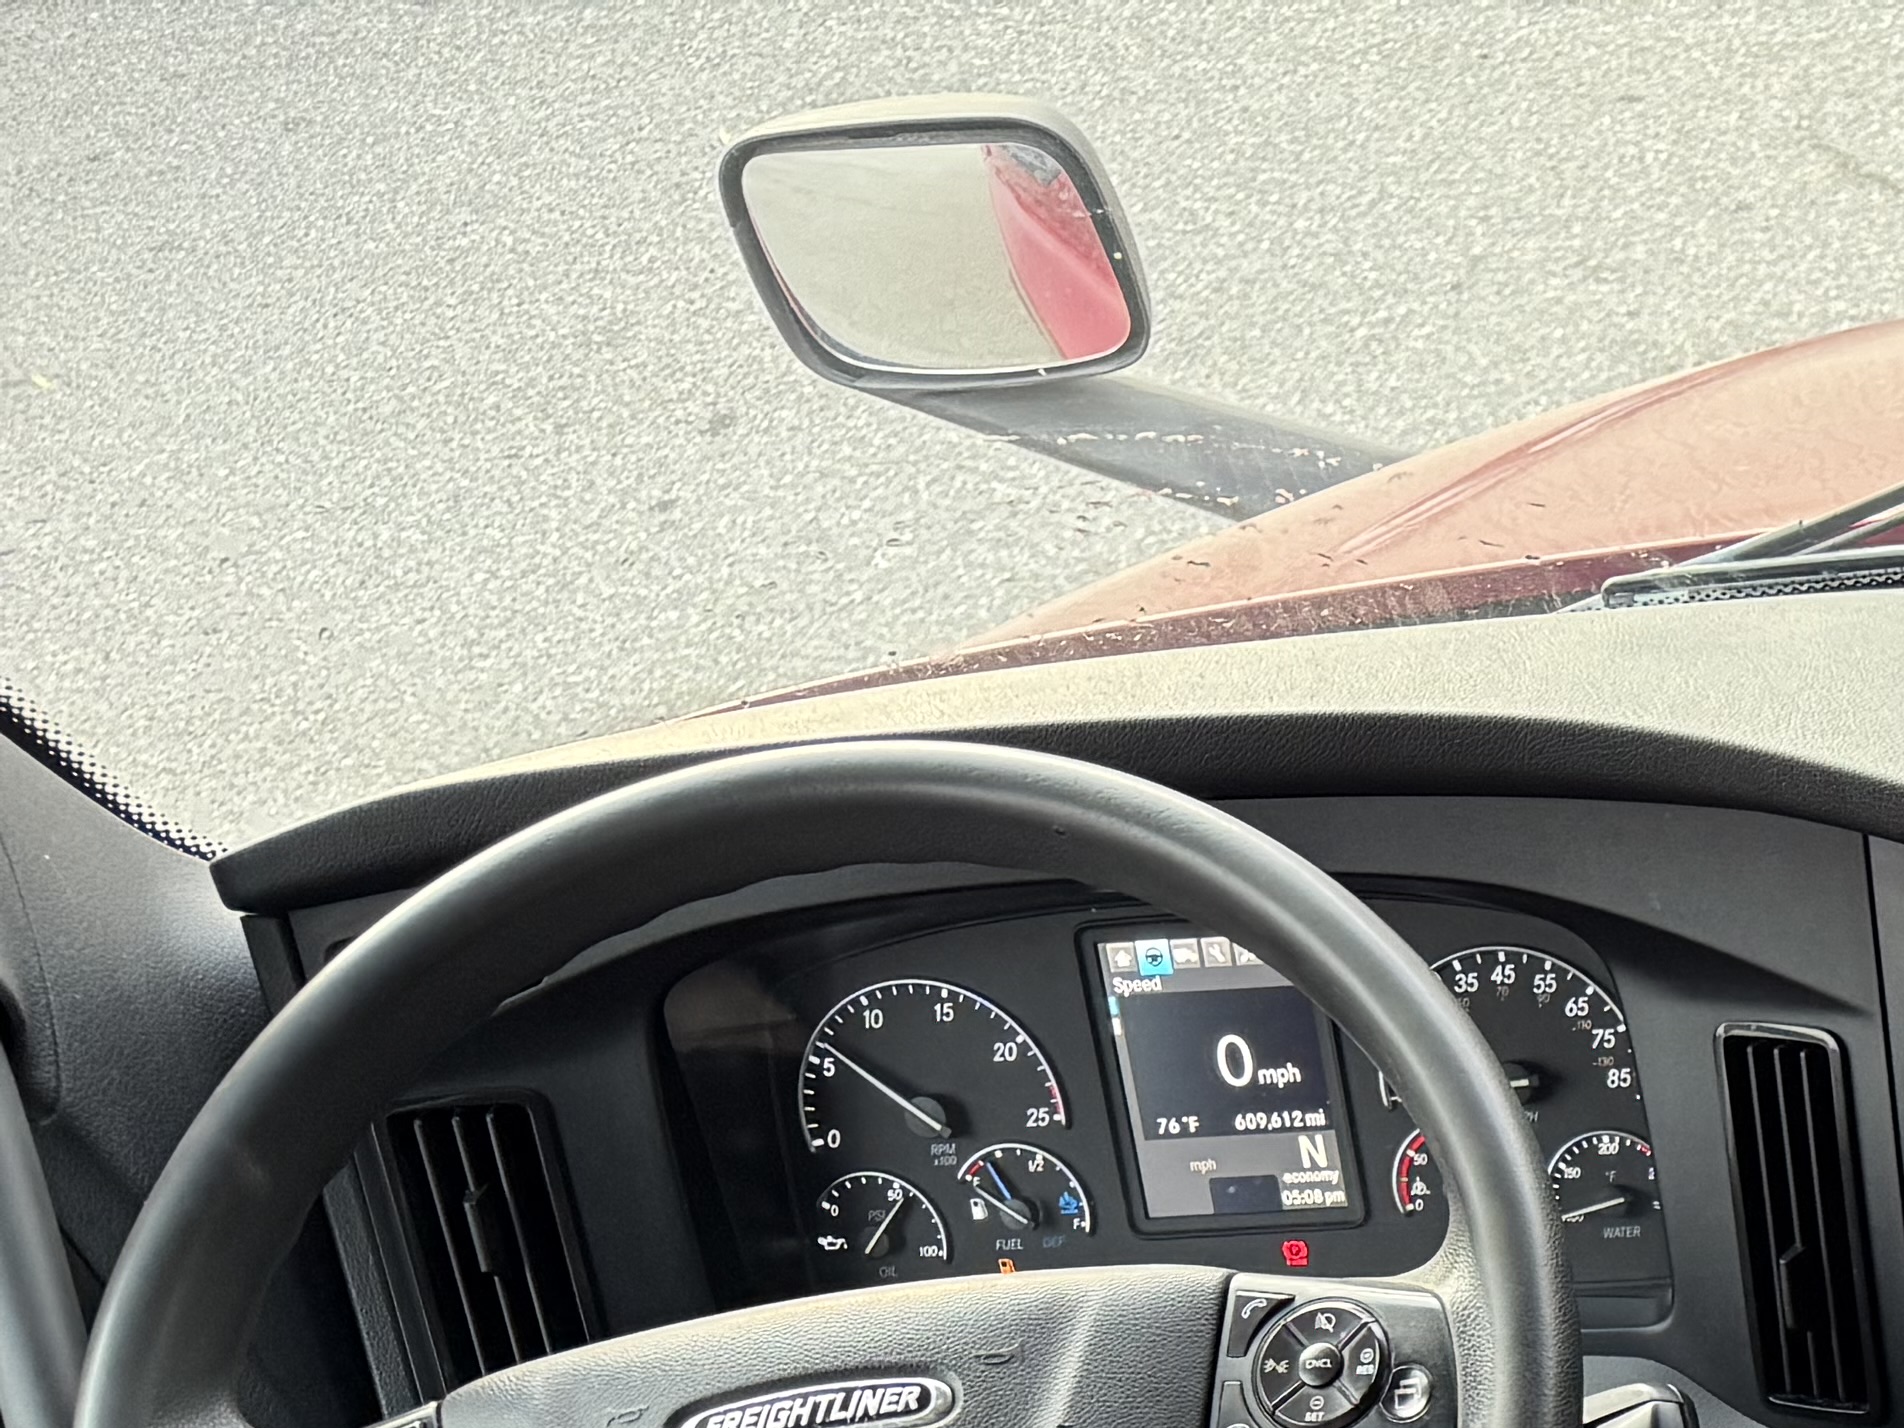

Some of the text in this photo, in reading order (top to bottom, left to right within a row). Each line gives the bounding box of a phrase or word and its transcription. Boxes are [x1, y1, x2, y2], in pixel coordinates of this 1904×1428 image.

[1454, 973, 1478, 993] 35
[1491, 965, 1515, 984] 45
[1533, 974, 1557, 994] 55
[1112, 976, 1162, 997] Speed
[934, 1003, 954, 1022] 15
[1565, 997, 1589, 1017] 65
[863, 1009, 883, 1029] 10
[1591, 1029, 1616, 1049] 75
[993, 1042, 1017, 1061] 20
[1217, 1034, 1302, 1088] 0 mph
[823, 1058, 835, 1077] 5
[1606, 1069, 1631, 1088] 85
[1026, 1108, 1049, 1127] 25
[827, 1129, 841, 1148] 0
[1298, 1134, 1328, 1168] N
[1599, 1144, 1619, 1155] 200
[1190, 1158, 1217, 1174] mph
[1413, 1154, 1428, 1165] 50
[1282, 1169, 1339, 1184] economy
[888, 1189, 903, 1200] 50
[831, 1205, 839, 1216] 0
[1603, 1226, 1641, 1239] WATER
[919, 1246, 938, 1258] 100
[996, 1240, 1023, 1250] FUEL
